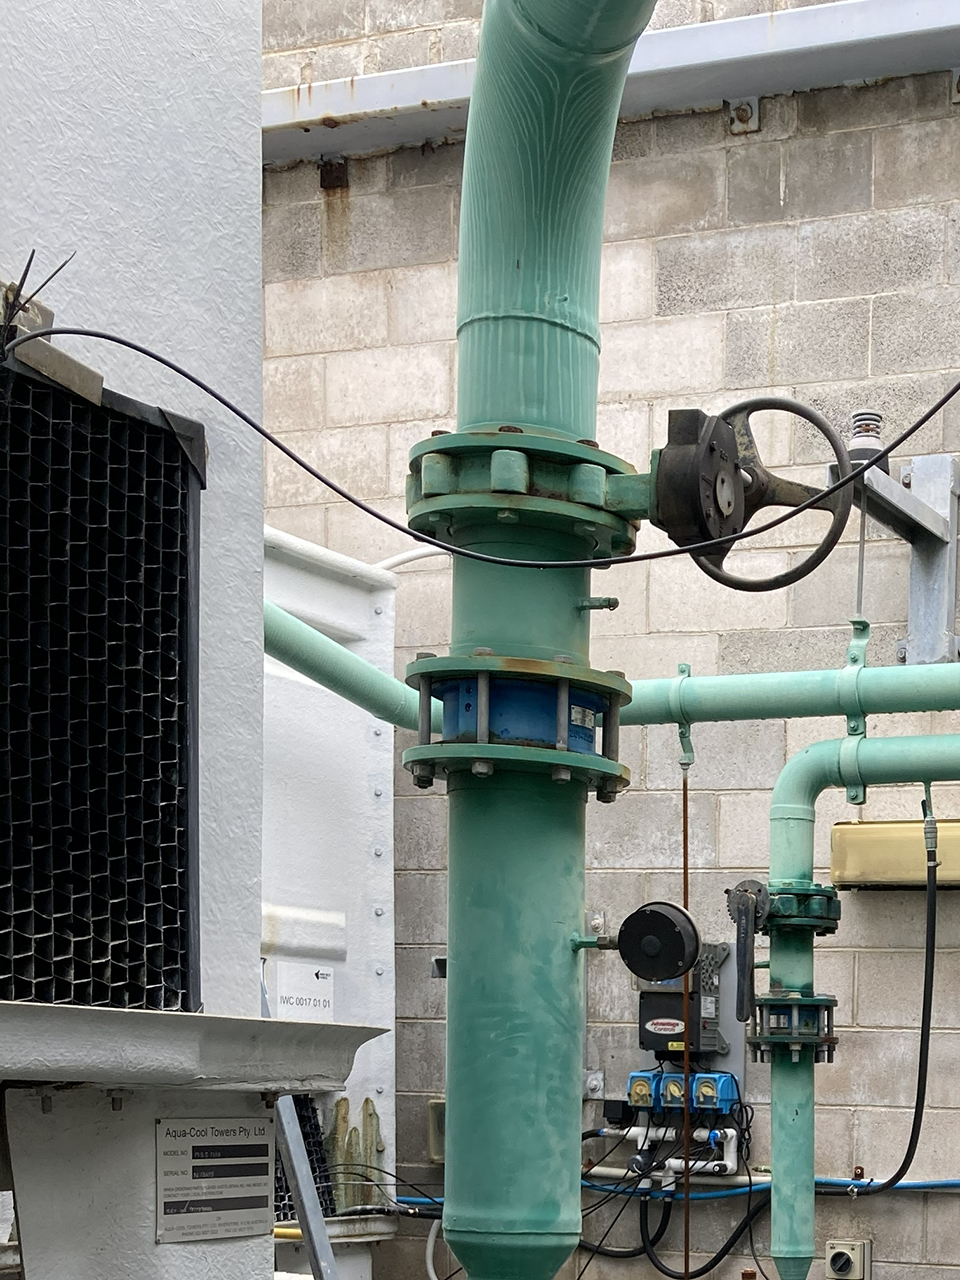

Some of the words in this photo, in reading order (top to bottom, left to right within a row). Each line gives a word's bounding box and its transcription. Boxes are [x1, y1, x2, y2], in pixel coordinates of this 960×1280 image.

[296, 996, 312, 1006] 0017
[313, 998, 321, 1007] 01
[322, 999, 330, 1008] 01
[165, 1127, 208, 1140] Aqua-Cool
[210, 1126, 237, 1137] Towers
